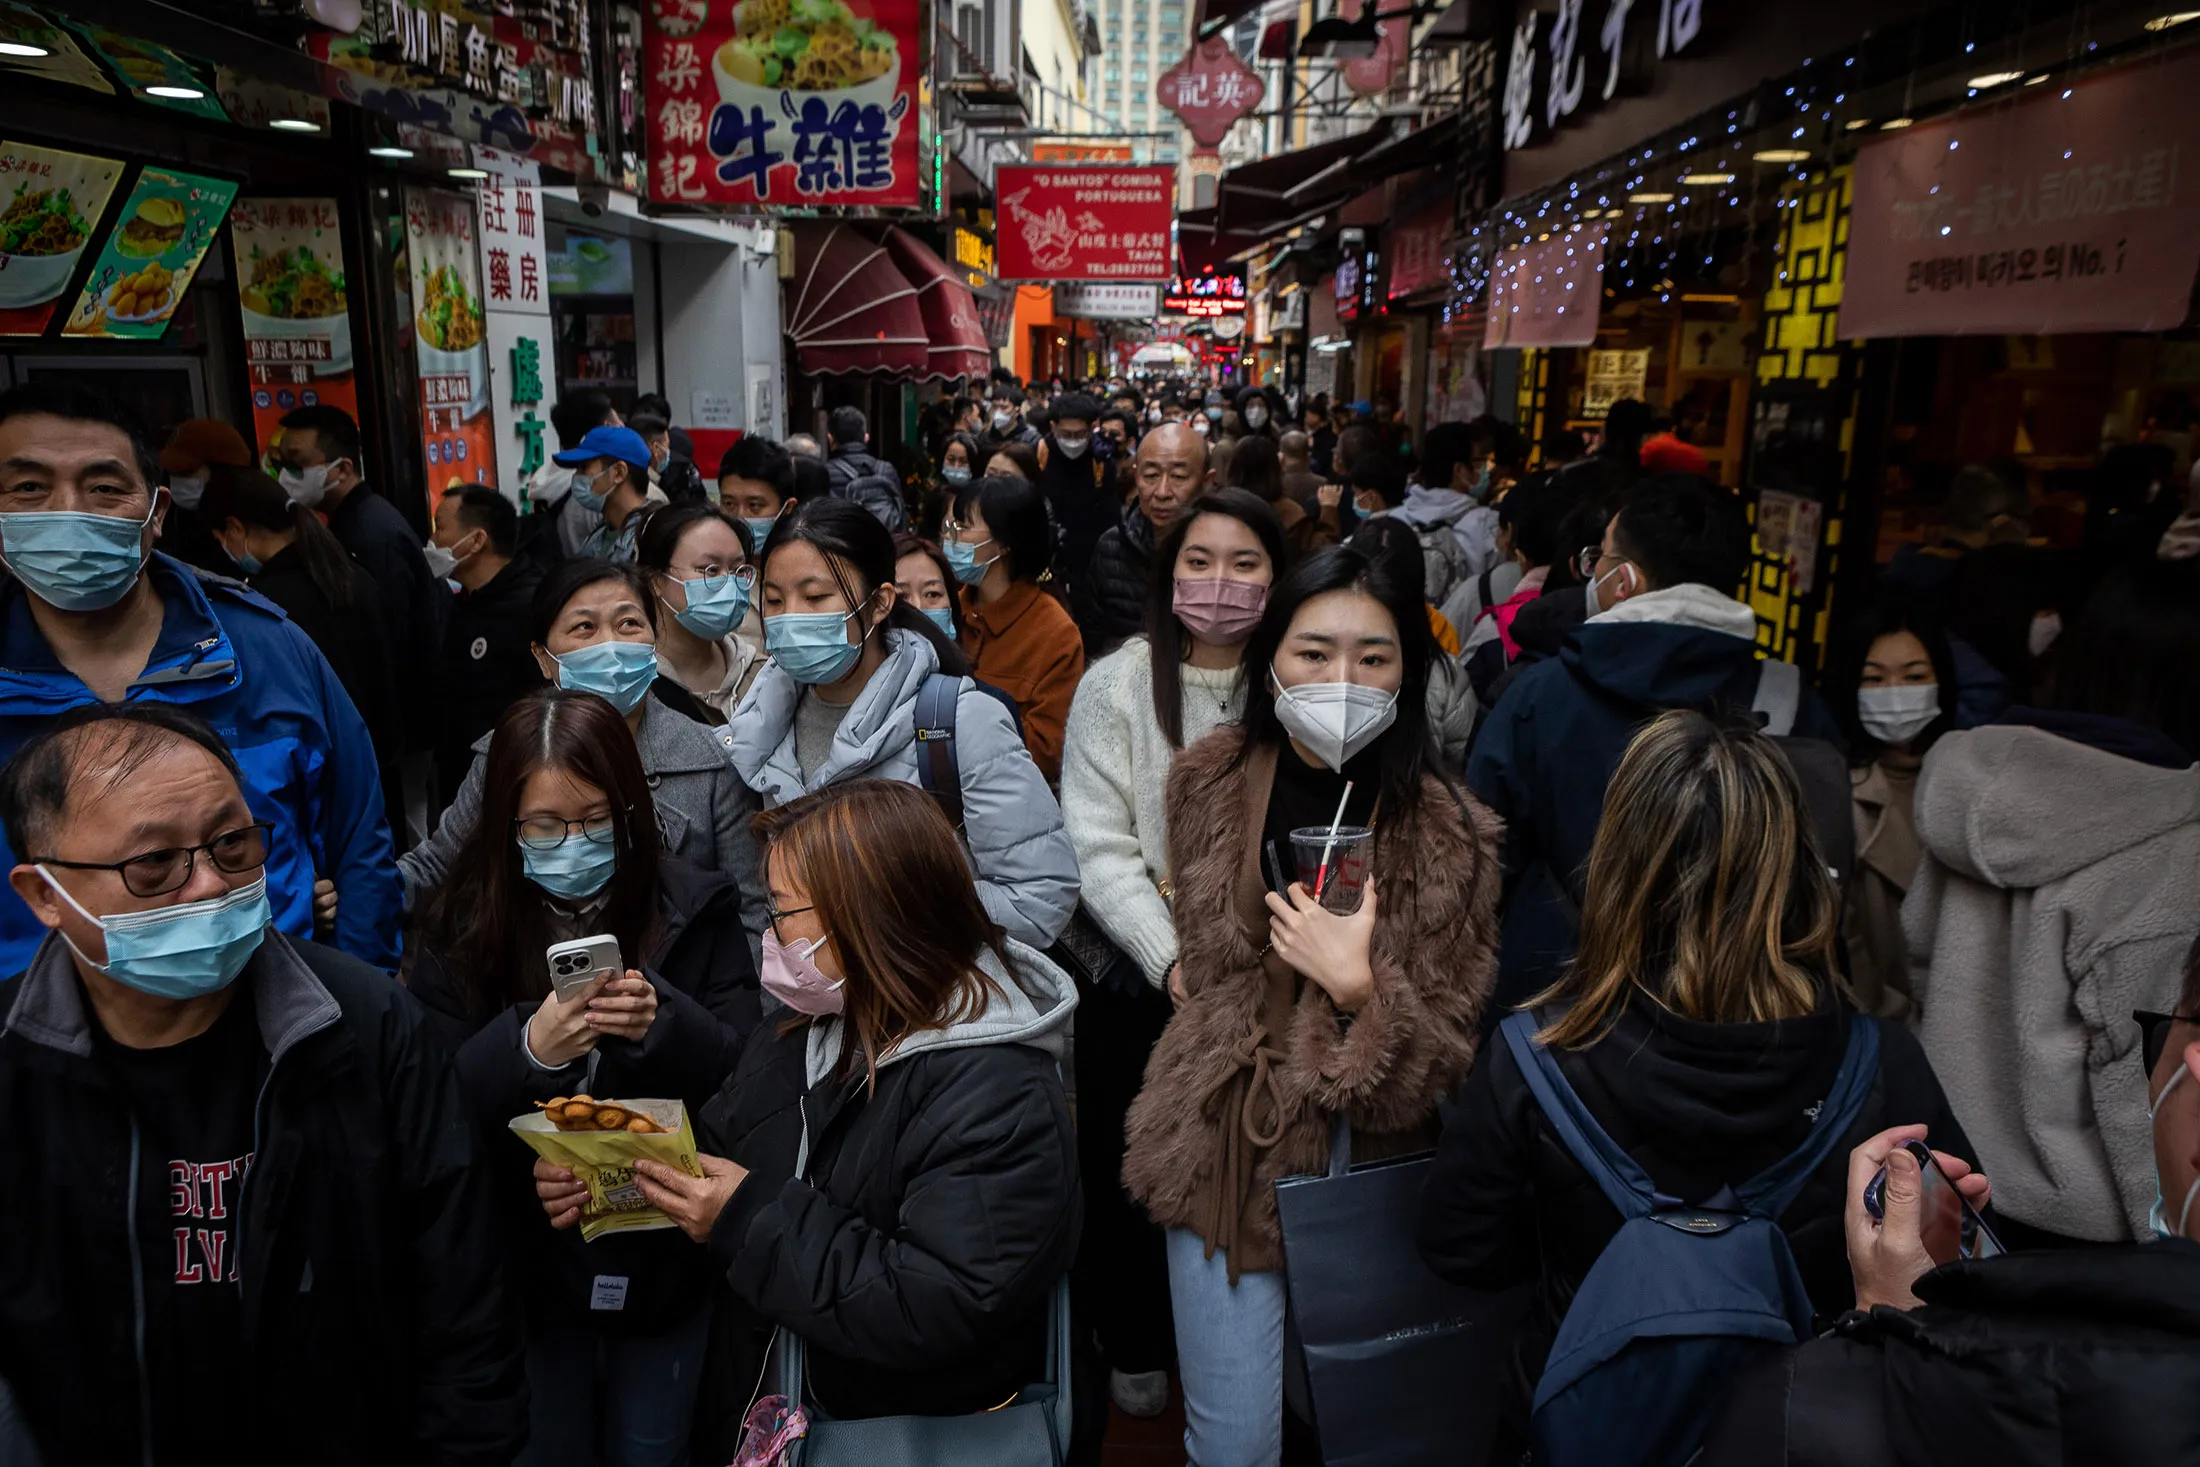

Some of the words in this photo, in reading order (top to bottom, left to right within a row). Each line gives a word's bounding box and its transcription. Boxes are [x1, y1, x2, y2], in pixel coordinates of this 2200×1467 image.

[656, 42, 707, 199] 梁錦記
[708, 95, 896, 198] 牛雜
[1075, 190, 1163, 204] PORTUGUESA
[1111, 174, 1163, 188] COMIDA
[1127, 250, 1164, 261] TAIPA
[173, 1226, 239, 1284] LV
